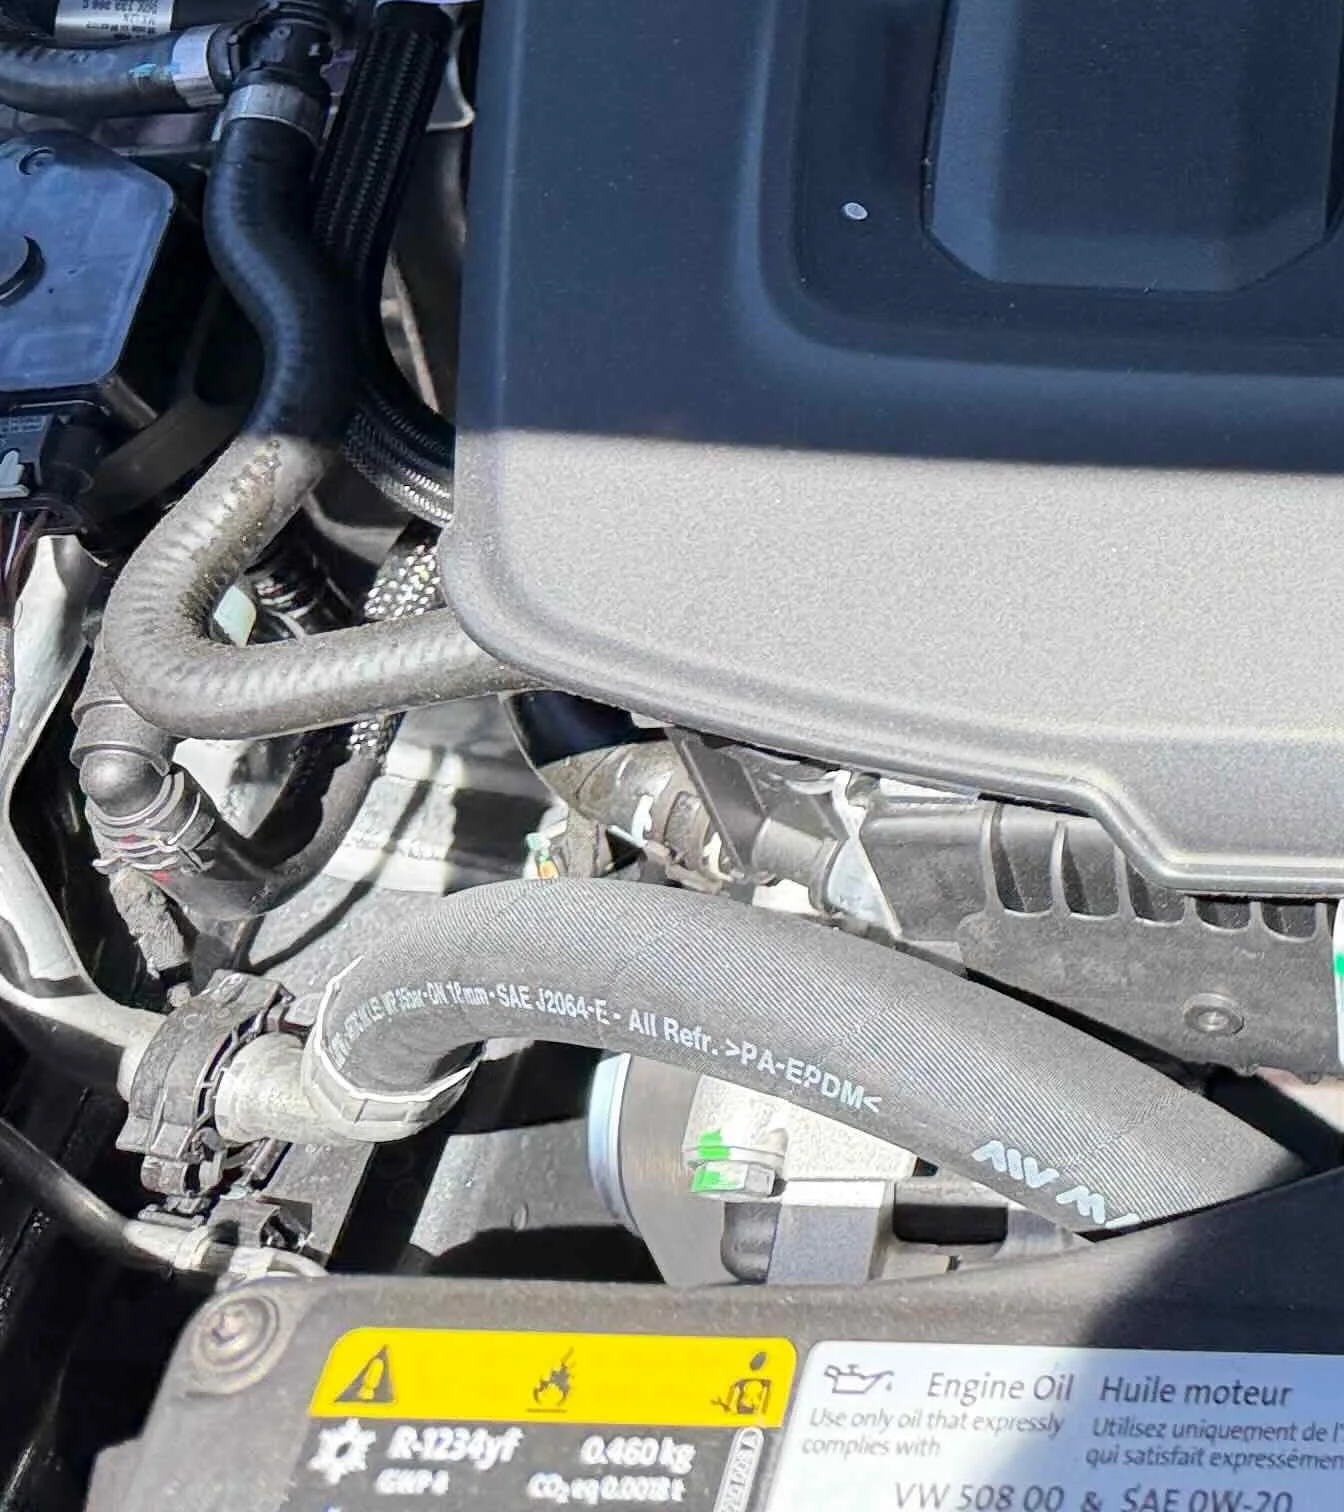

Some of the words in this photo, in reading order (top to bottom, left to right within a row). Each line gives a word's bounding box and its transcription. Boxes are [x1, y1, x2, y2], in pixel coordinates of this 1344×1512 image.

[498, 983, 533, 1010] SAE
[628, 1008, 657, 1038] All
[663, 1016, 719, 1057] Refr.
[926, 1371, 1025, 1407] Engine
[1033, 1373, 1075, 1402] Oil
[1099, 1375, 1175, 1405] Huile
[1184, 1379, 1295, 1406] moteur
[808, 1406, 845, 1429] Use
[849, 1407, 895, 1432] only
[896, 1408, 924, 1429] oil
[926, 1410, 968, 1431] that
[971, 1414, 1066, 1440] expressly
[1092, 1417, 1166, 1442] Utilisez
[1172, 1421, 1298, 1448] uniquement
[1302, 1422, 1329, 1444] de
[385, 1425, 525, 1471] R-1234yf
[579, 1434, 660, 1468] 0.460
[660, 1438, 698, 1474] kg
[800, 1435, 891, 1460] complies
[894, 1437, 942, 1458] with
[1085, 1444, 1121, 1469] qui
[1124, 1444, 1204, 1469] satisfait
[893, 1481, 952, 1510] VW
[956, 1483, 1017, 1512] 508
[1022, 1484, 1066, 1512] 00
[1080, 1490, 1104, 1512] &
[1120, 1485, 1184, 1512] SAE
[1186, 1488, 1295, 1512] 0W-20
